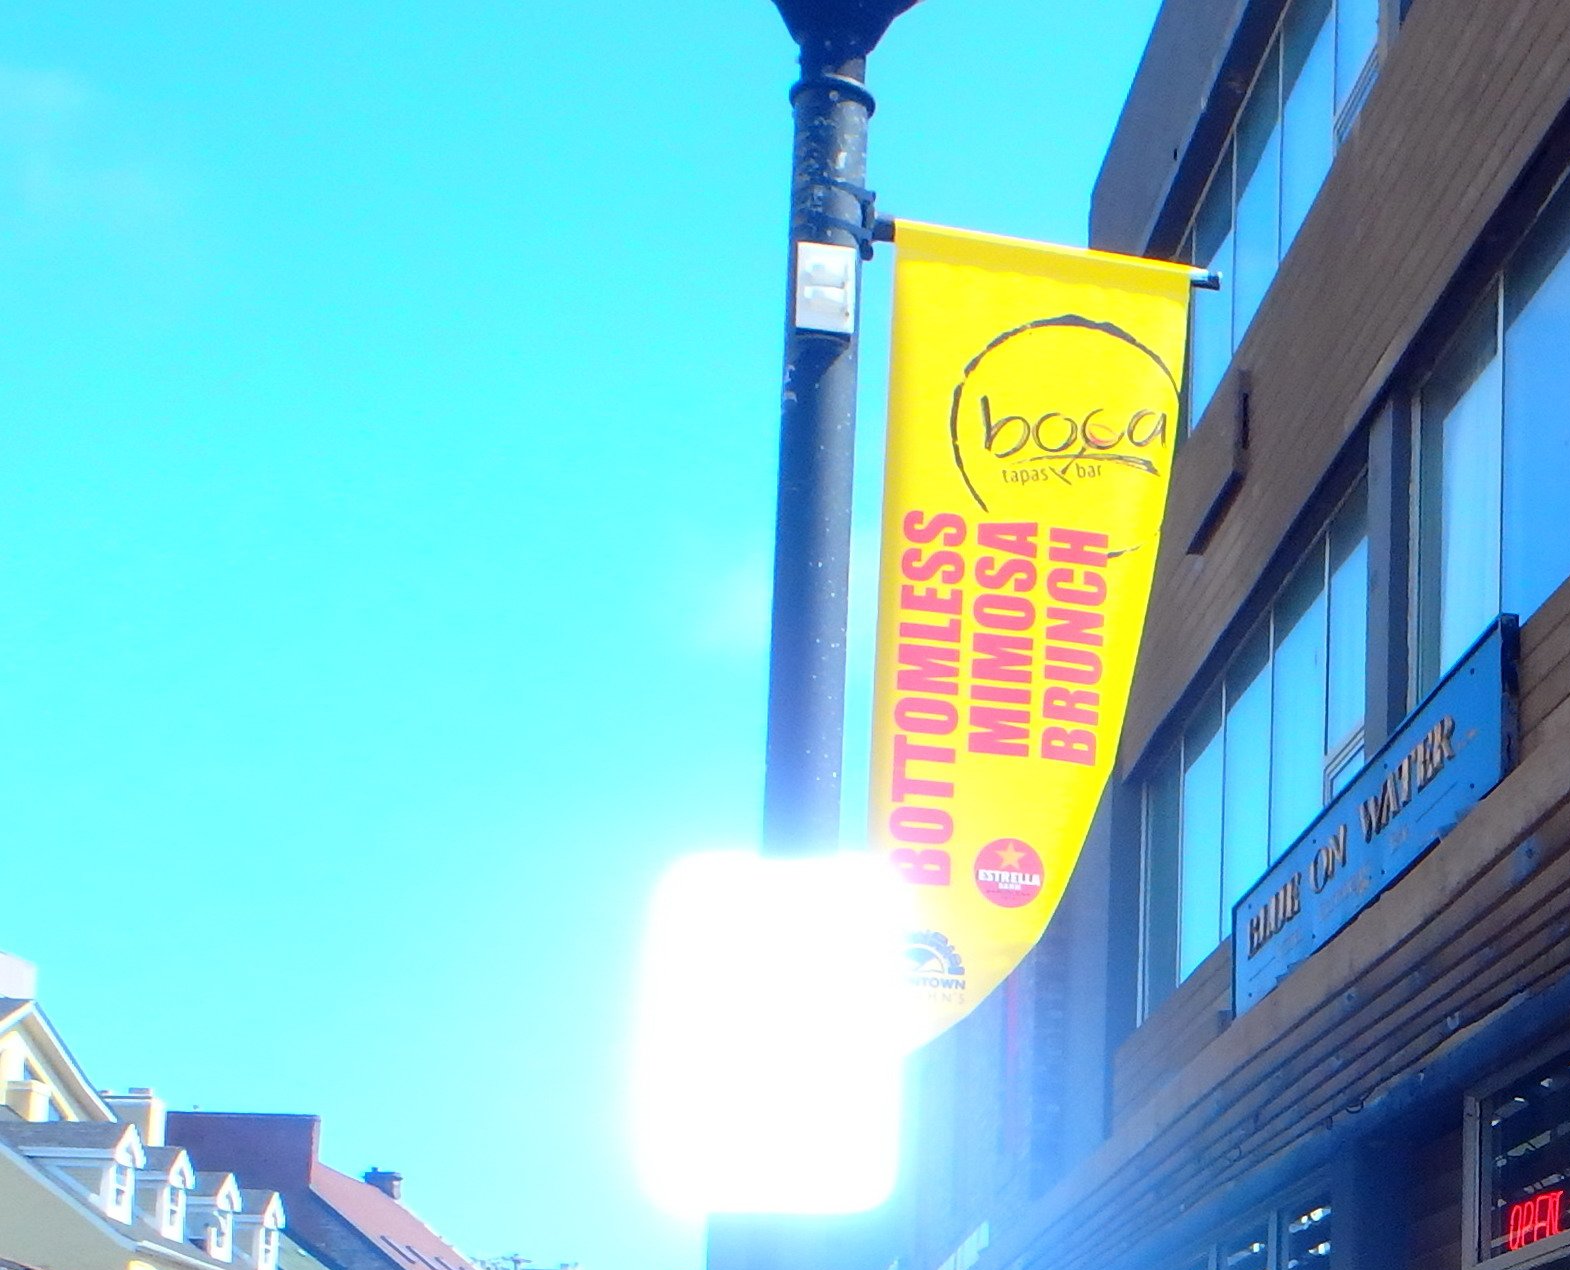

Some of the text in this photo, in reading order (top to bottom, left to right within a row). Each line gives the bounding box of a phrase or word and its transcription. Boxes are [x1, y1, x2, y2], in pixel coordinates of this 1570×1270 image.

[980, 395, 1168, 459] boca
[1002, 463, 1102, 485] tapas bar
[889, 510, 967, 887] BOTTOMLESS
[968, 521, 1038, 757] MIMOSA
[1041, 527, 1109, 767] BRUNCH
[1310, 824, 1347, 893] ON
[1360, 715, 1455, 843] WATER
[978, 869, 1041, 886] ESTRELLA
[1509, 1190, 1563, 1251] OPEN
